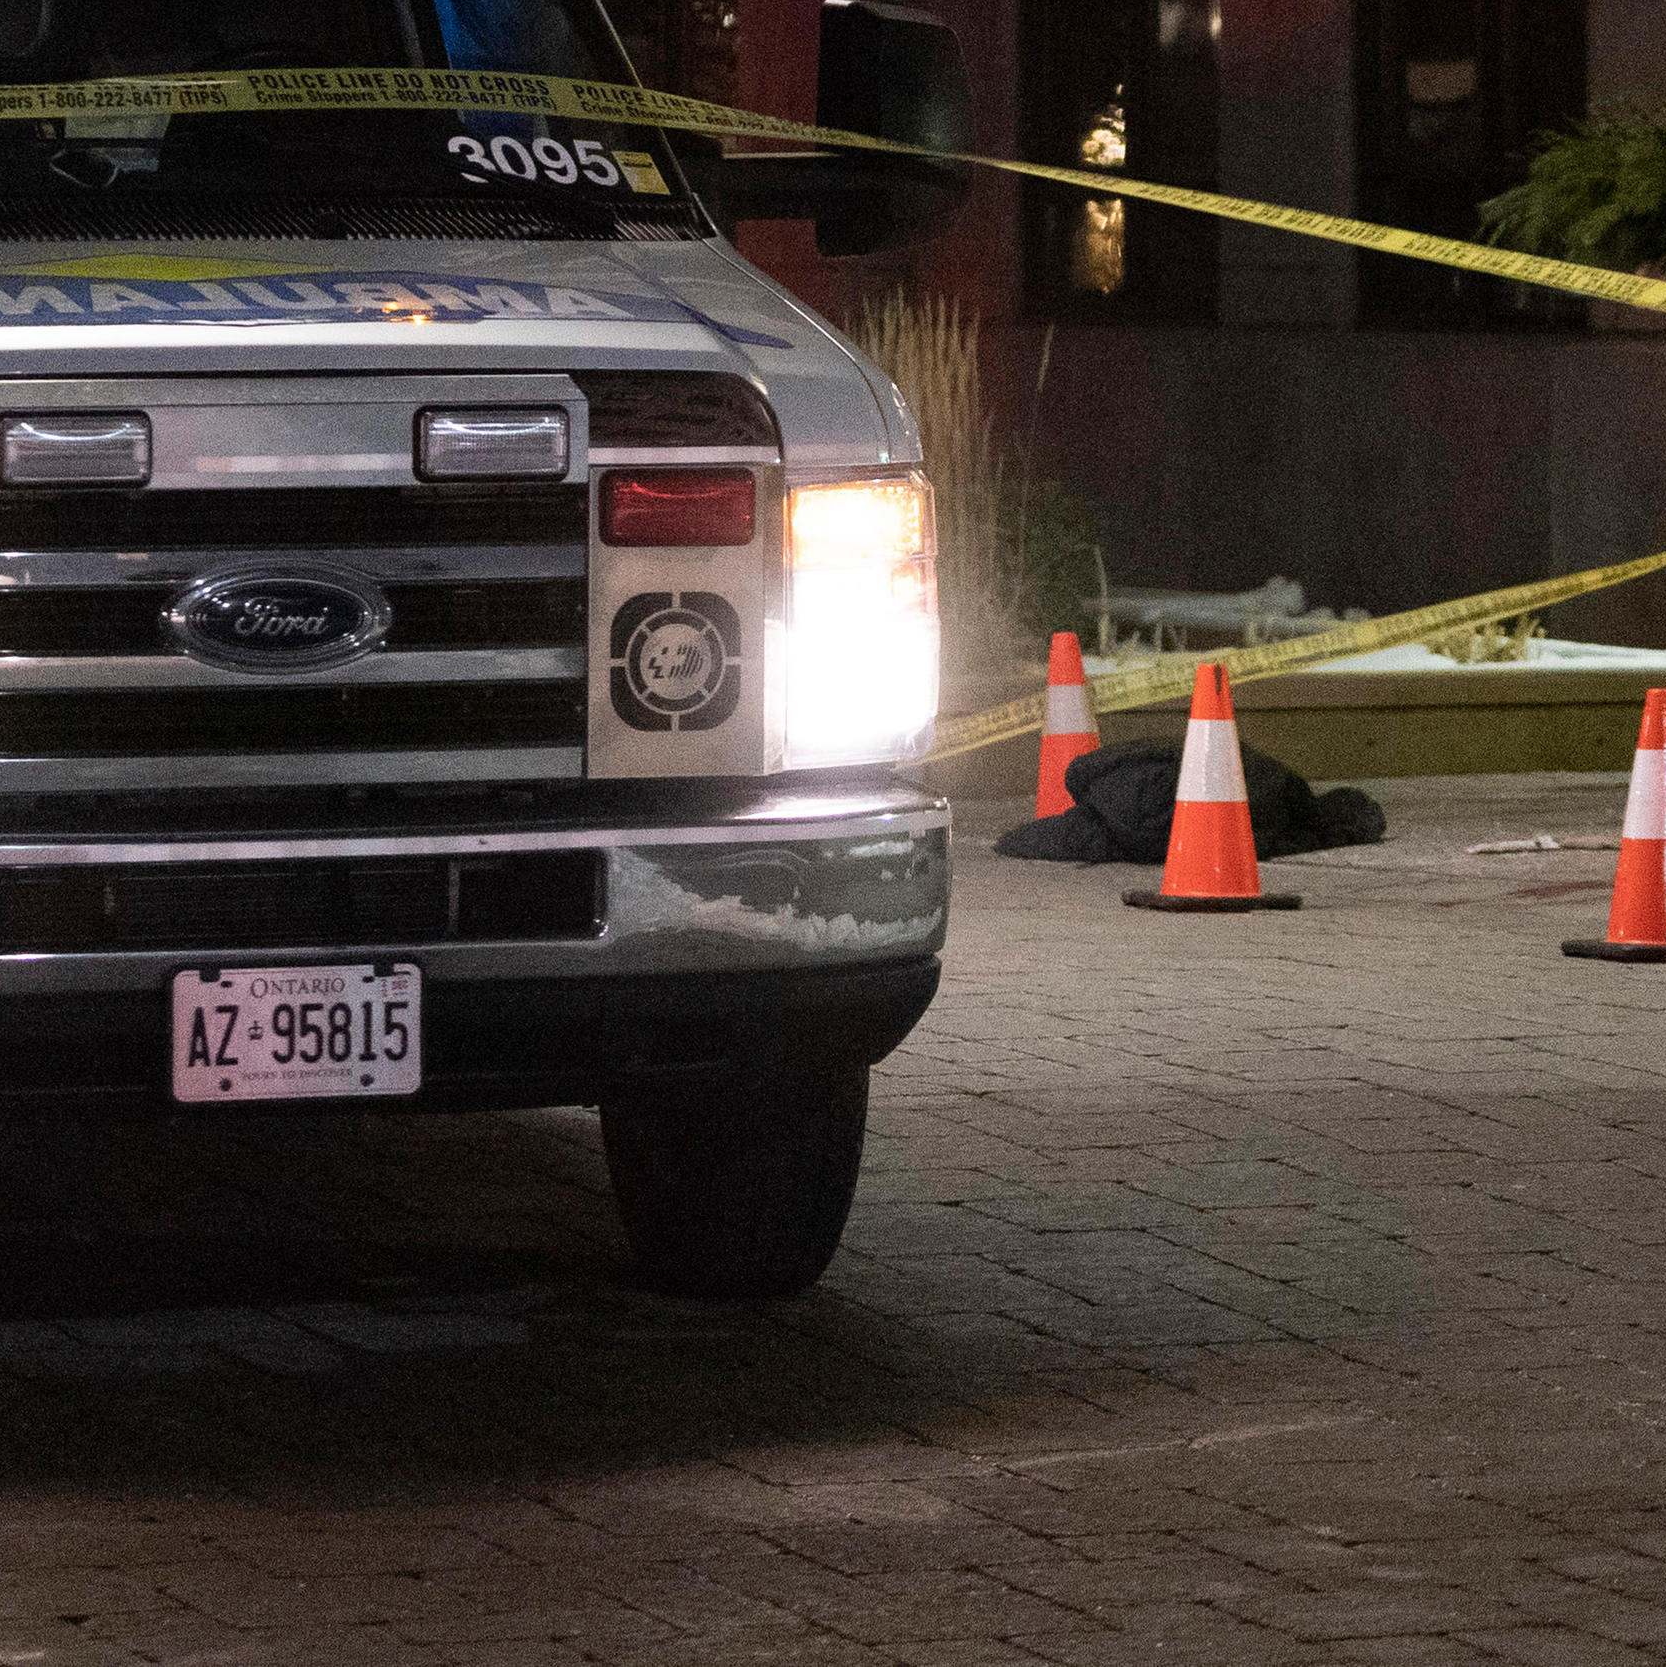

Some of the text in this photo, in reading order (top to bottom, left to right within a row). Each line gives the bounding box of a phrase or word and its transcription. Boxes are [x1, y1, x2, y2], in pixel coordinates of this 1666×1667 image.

[247, 73, 329, 89] POLICE
[336, 72, 385, 88] LINE
[392, 73, 423, 88] DO
[432, 74, 472, 90] NOT
[478, 76, 551, 95] CROSS
[39, 91, 172, 108] 1-800-222-8477
[178, 89, 229, 107] (TIPS)
[255, 90, 303, 105] Crime
[309, 90, 376, 106] Stoppers
[381, 89, 508, 105] 1-800-222-8477
[573, 84, 644, 108] POLICE
[448, 136, 620, 186] 3095
[234, 595, 330, 636] Ford
[250, 977, 346, 998] ONTARIO
[187, 1001, 410, 1067] AZ 95815
